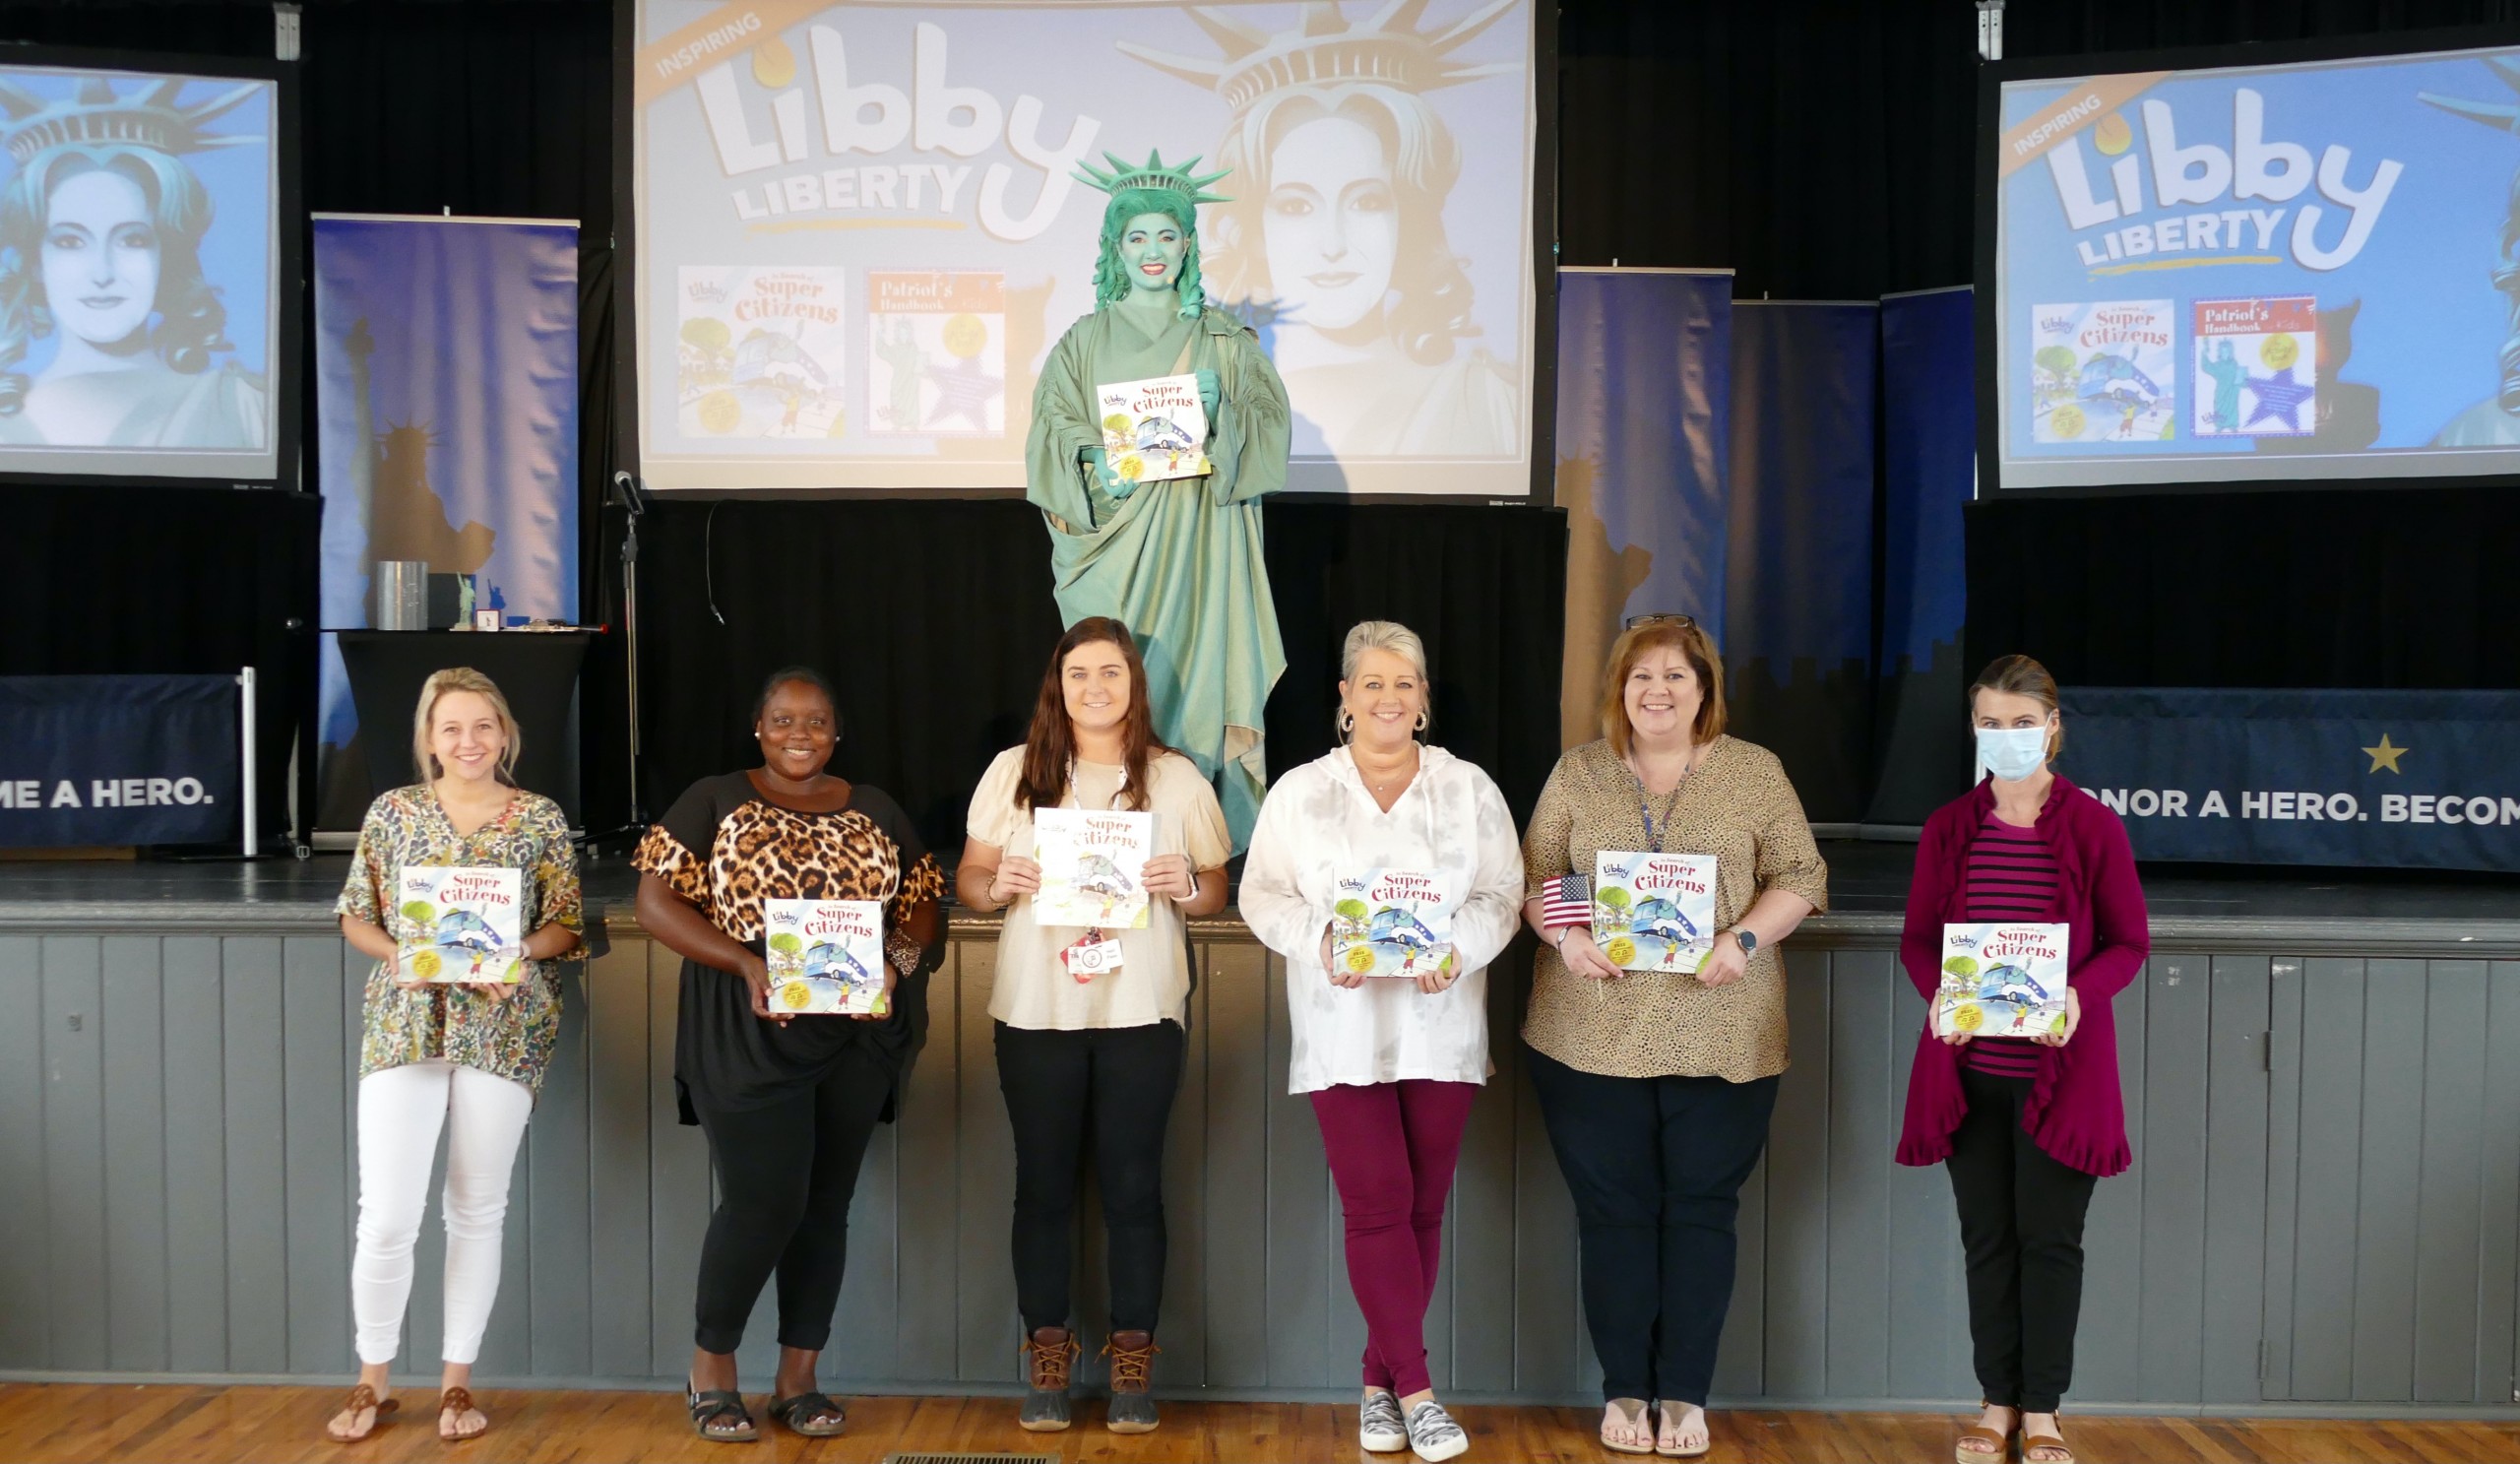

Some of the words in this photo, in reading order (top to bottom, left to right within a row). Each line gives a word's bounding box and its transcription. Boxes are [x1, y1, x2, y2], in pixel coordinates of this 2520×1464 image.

[655, 11, 762, 79] INSPIRING
[695, 22, 1102, 243] Libby
[2014, 95, 2102, 156] INSPIRING
[2045, 88, 2405, 273] Libby
[730, 163, 973, 222] LIBERTY
[2075, 209, 2288, 268] LIBERTY
[754, 277, 824, 301] Super
[881, 279, 954, 298] Patriot's
[734, 297, 839, 324] Citizens
[880, 298, 945, 311] Handbook
[2096, 311, 2156, 329] Super
[2205, 306, 2269, 323] Patriot's
[2204, 322, 2261, 335] Handbook
[2080, 328, 2169, 348] Citizens
[1103, 394, 1127, 407] Libby
[1142, 386, 1183, 399] Super
[1133, 397, 1194, 414] Citizens
[49, 780, 83, 808] A
[92, 776, 215, 807] HERO.
[2198, 790, 2231, 818] A
[2241, 791, 2368, 821] HERO.
[1086, 816, 1133, 834] Super
[1073, 831, 1140, 849] itizens
[1603, 863, 1630, 879] Libby
[1648, 860, 1696, 877] Super
[453, 874, 501, 890] Super
[1339, 877, 1366, 892] Libby
[1384, 874, 1431, 888] Super
[1634, 874, 1706, 895] Citizens
[439, 888, 511, 906] Citizens
[1371, 886, 1442, 904] Citizens
[772, 911, 799, 925] Libby
[816, 907, 862, 923] Super
[804, 921, 873, 938] Citizens
[1997, 929, 2047, 945] Super
[1949, 934, 1978, 948] Libby
[1983, 942, 2057, 960] Citizens
